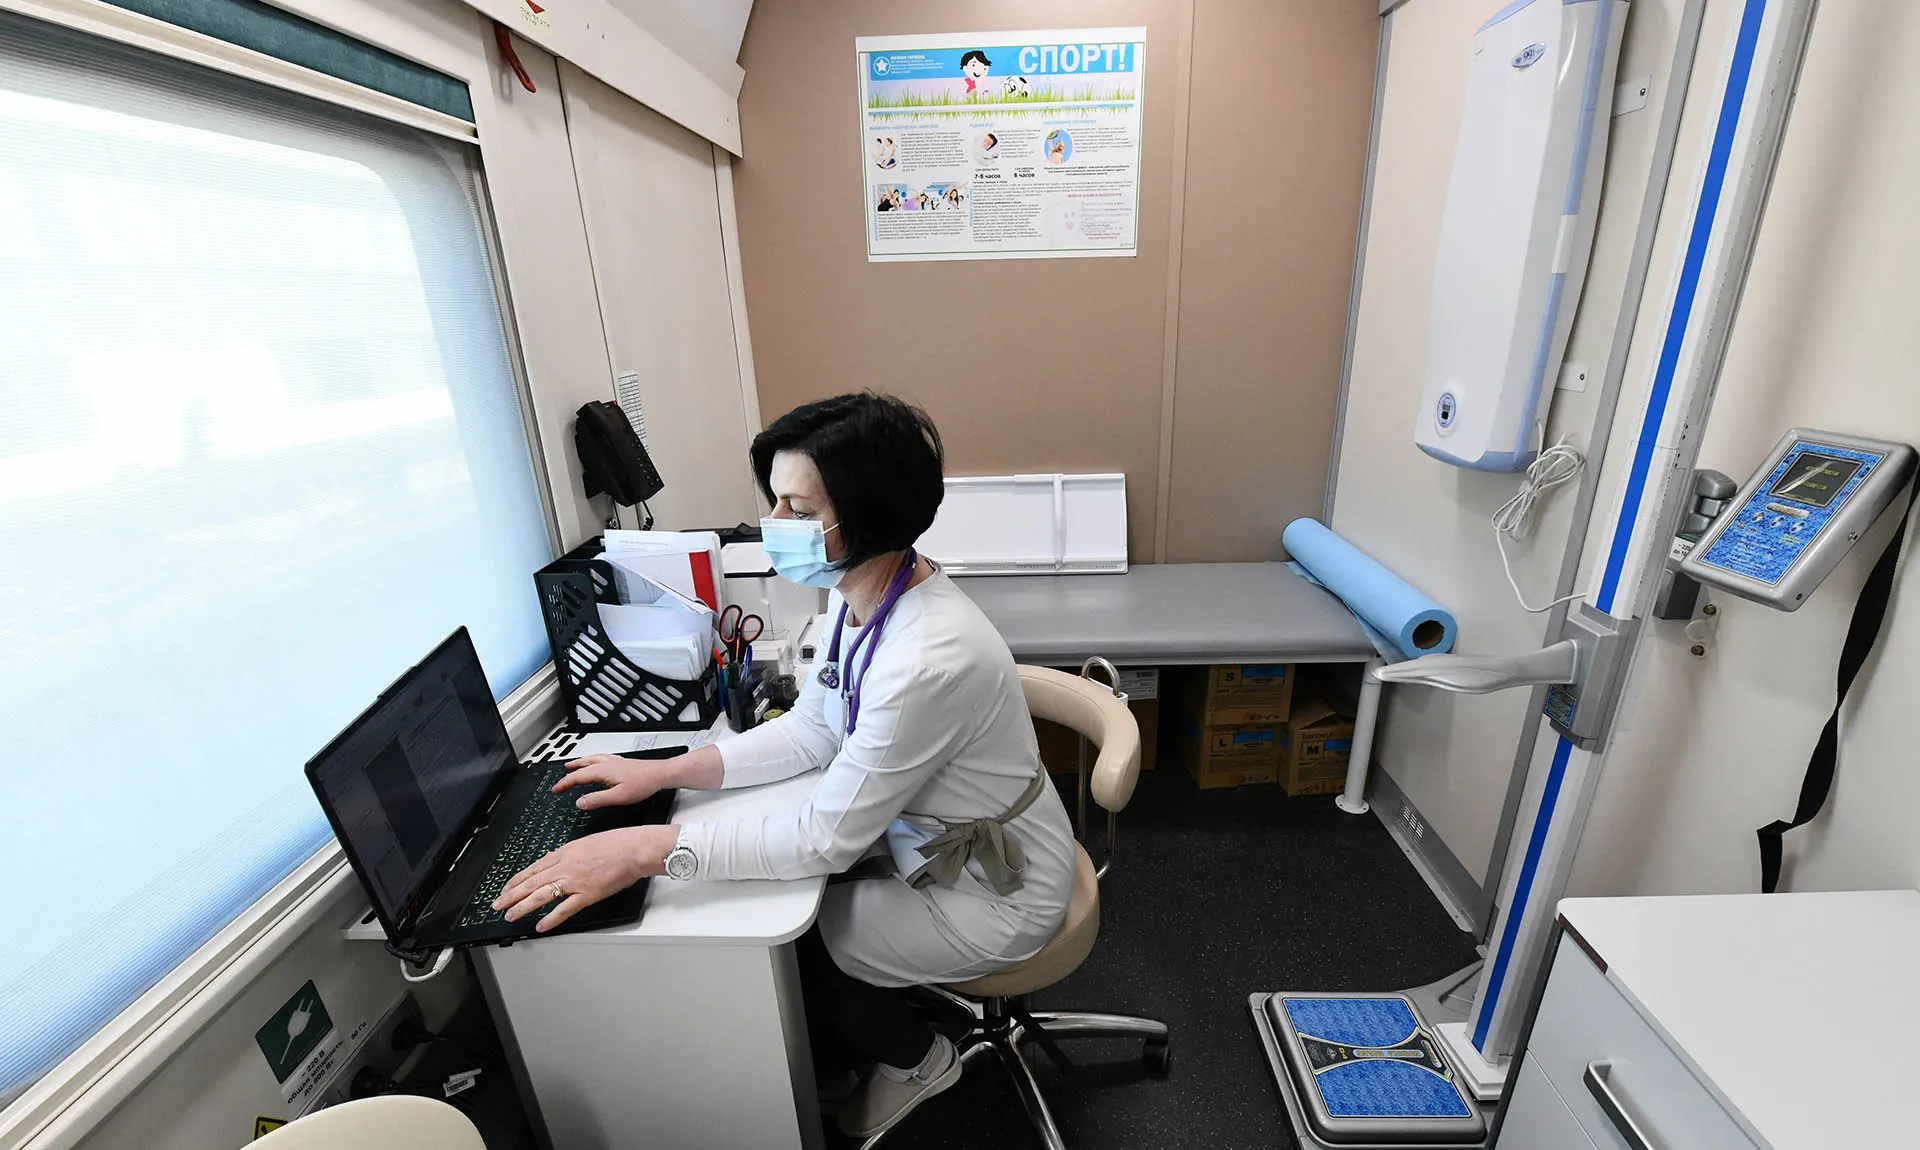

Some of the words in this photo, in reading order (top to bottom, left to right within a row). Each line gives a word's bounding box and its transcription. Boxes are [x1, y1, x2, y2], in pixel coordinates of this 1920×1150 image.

[1018, 44, 1126, 73] СПОРТ!
[1225, 672, 1236, 682] S
[1219, 738, 1226, 747] L
[1307, 745, 1319, 755] M
[306, 1057, 319, 1072] 220
